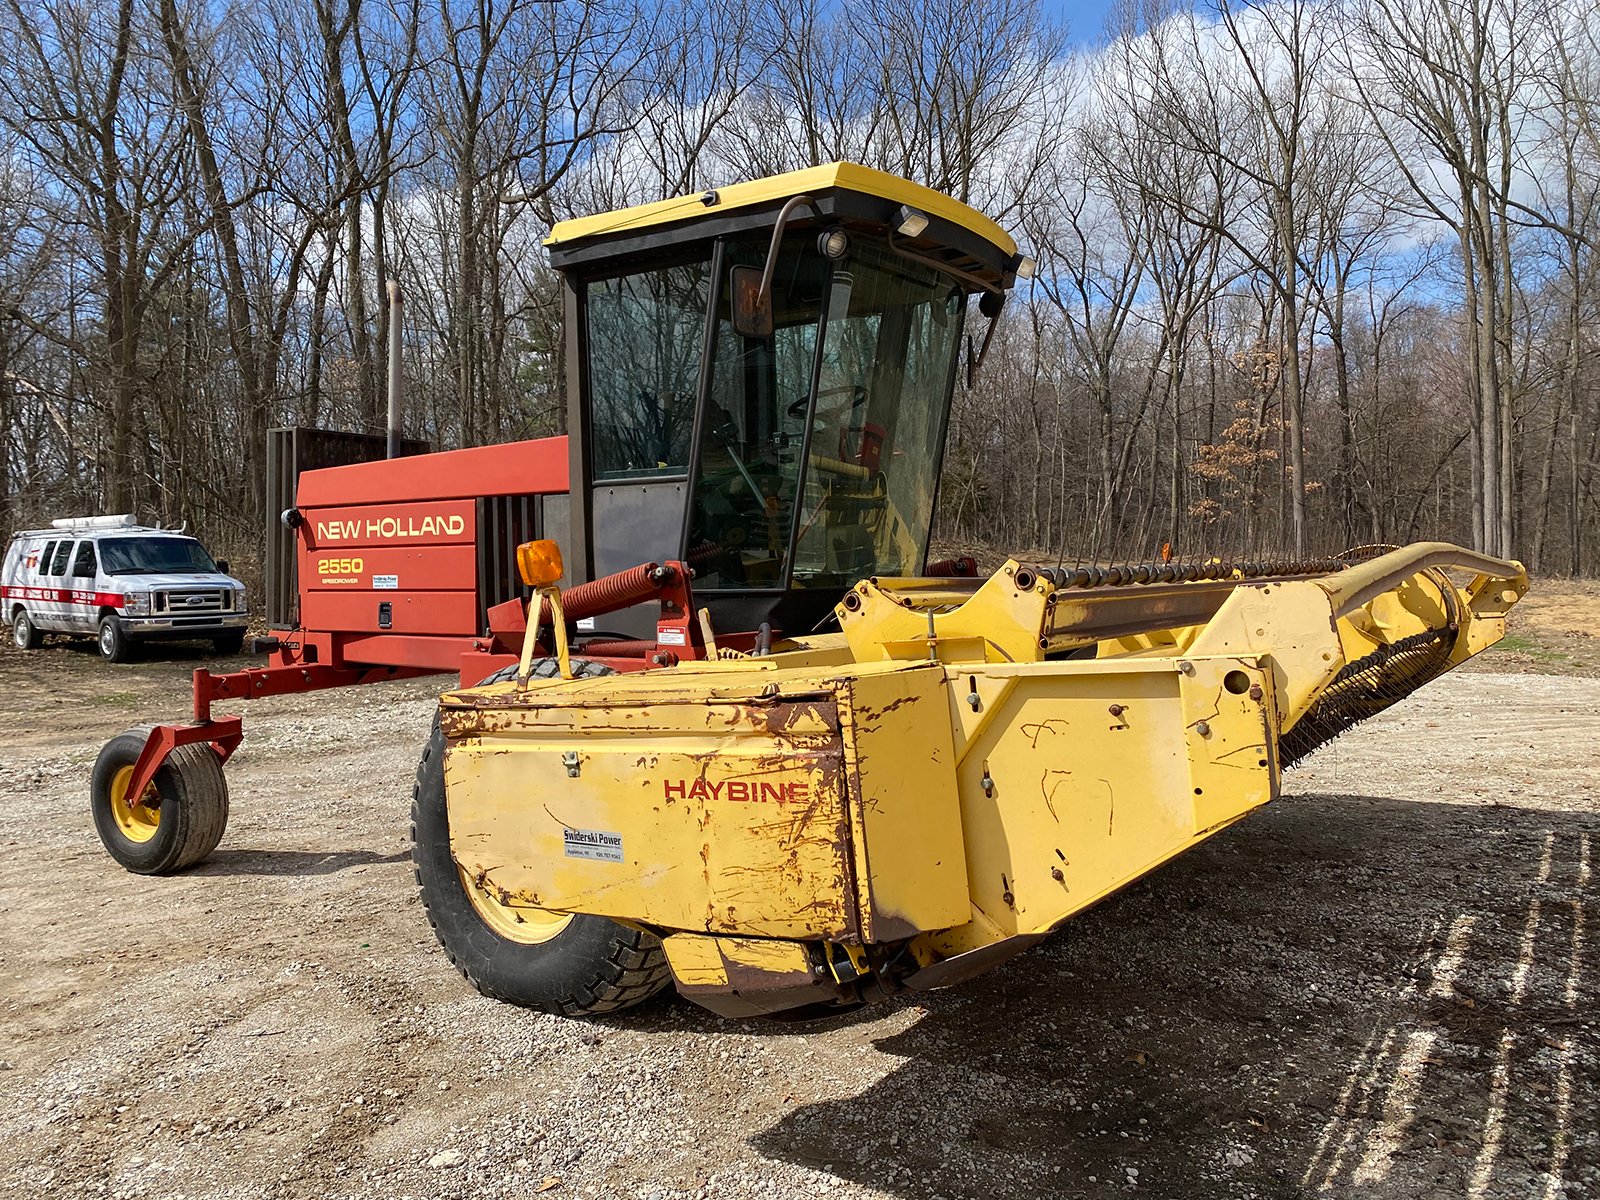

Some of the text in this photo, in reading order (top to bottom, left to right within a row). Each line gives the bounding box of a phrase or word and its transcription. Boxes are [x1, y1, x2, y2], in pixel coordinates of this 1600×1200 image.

[318, 515, 465, 540] NEW HOLLAND
[318, 558, 364, 574] 2550
[663, 779, 810, 804] HAYBINE
[564, 830, 621, 845] Swiderski Power
